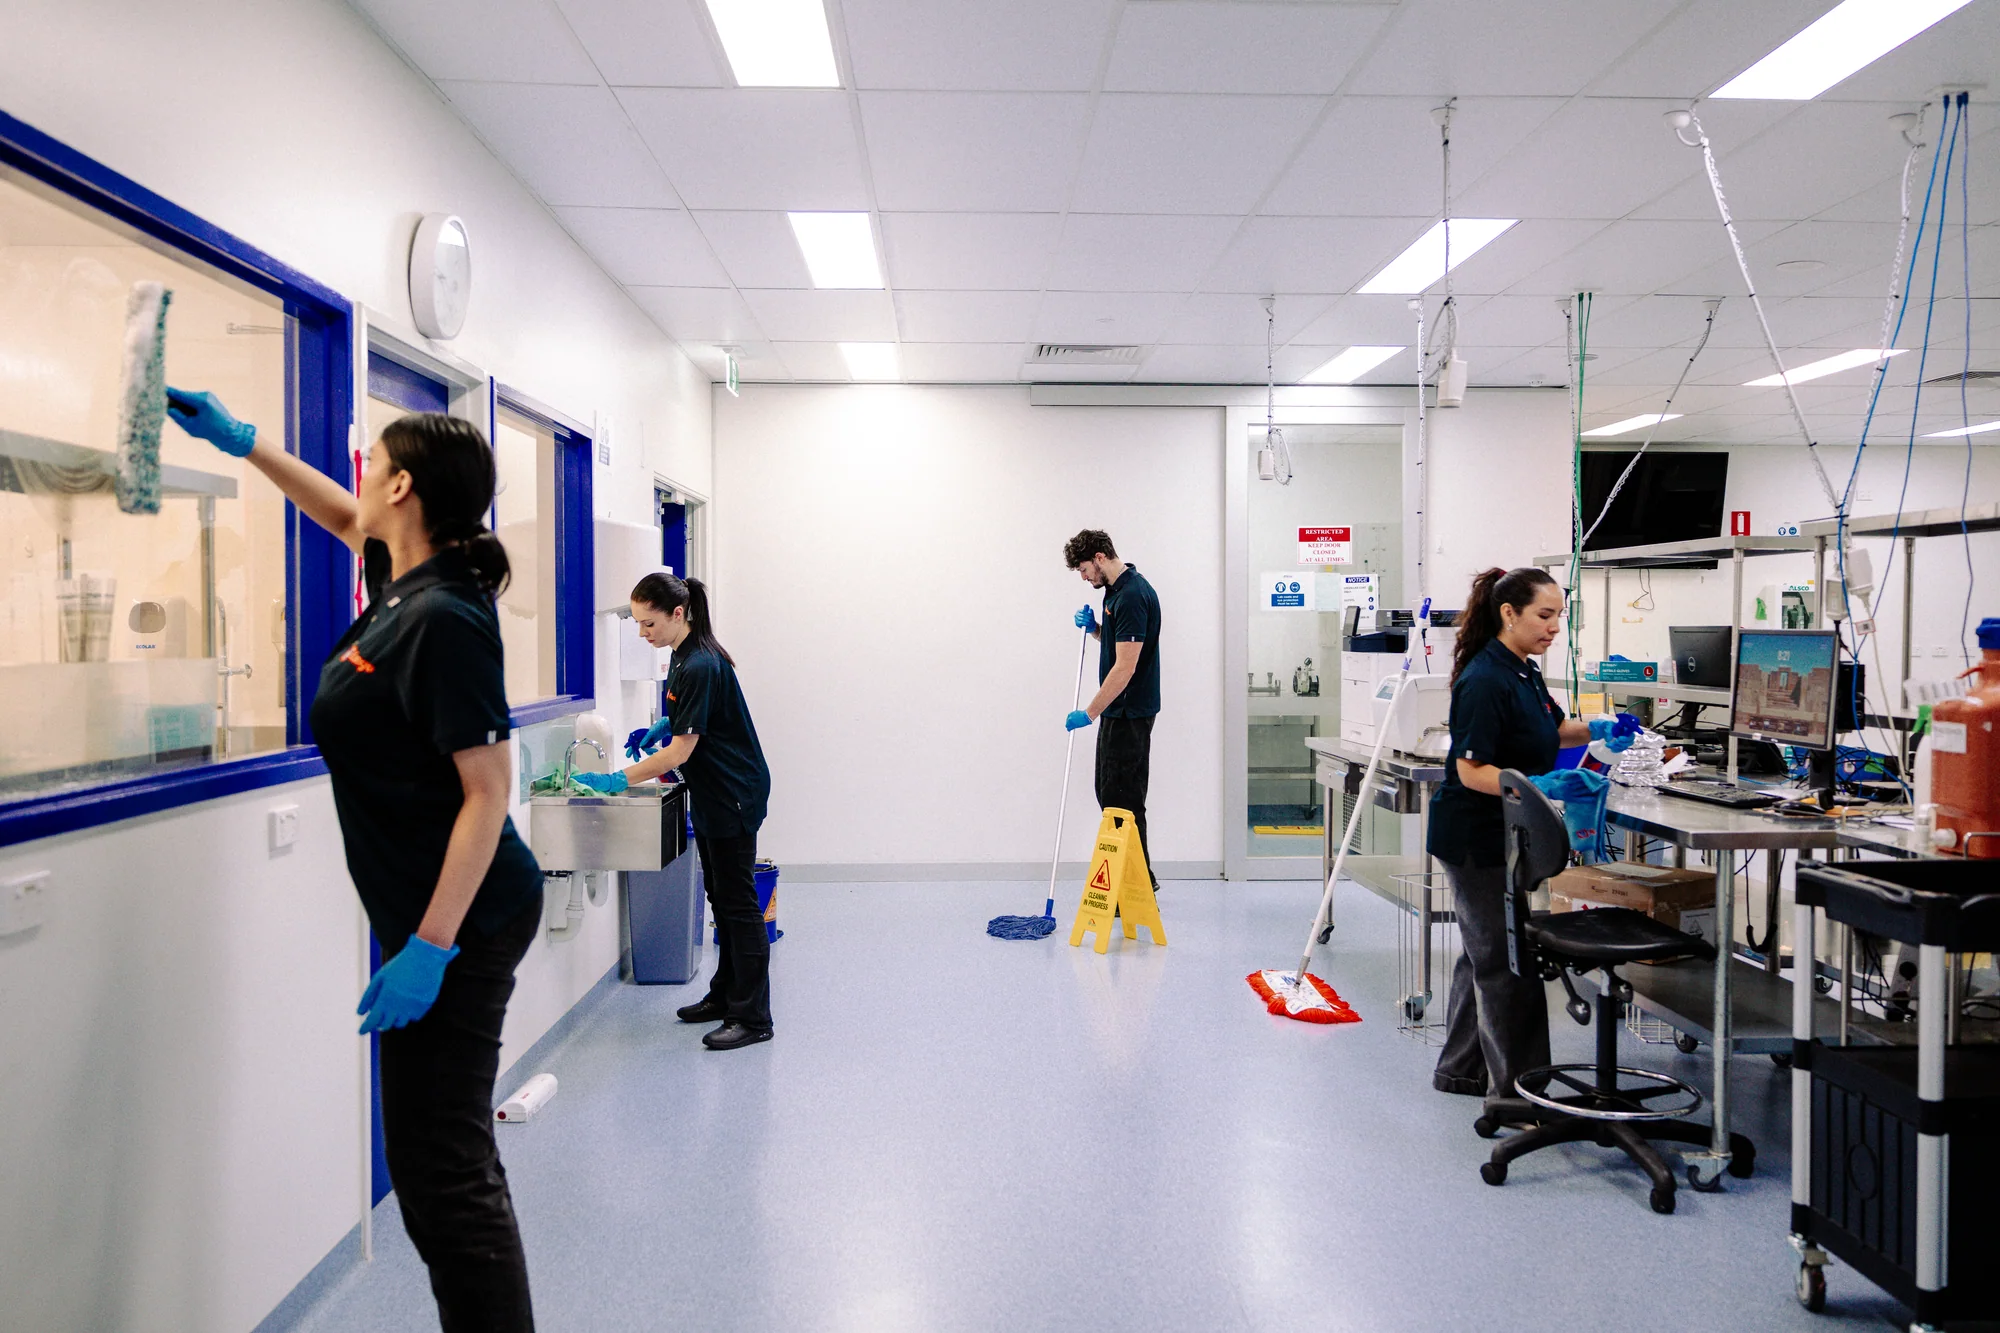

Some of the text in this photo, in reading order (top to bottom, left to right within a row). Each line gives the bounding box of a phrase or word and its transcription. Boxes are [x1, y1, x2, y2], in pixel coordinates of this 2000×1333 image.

[1099, 843, 1118, 852] CAUTION
[1088, 892, 1107, 902] CLEANING
[1088, 899, 1108, 910] PROGRESS
